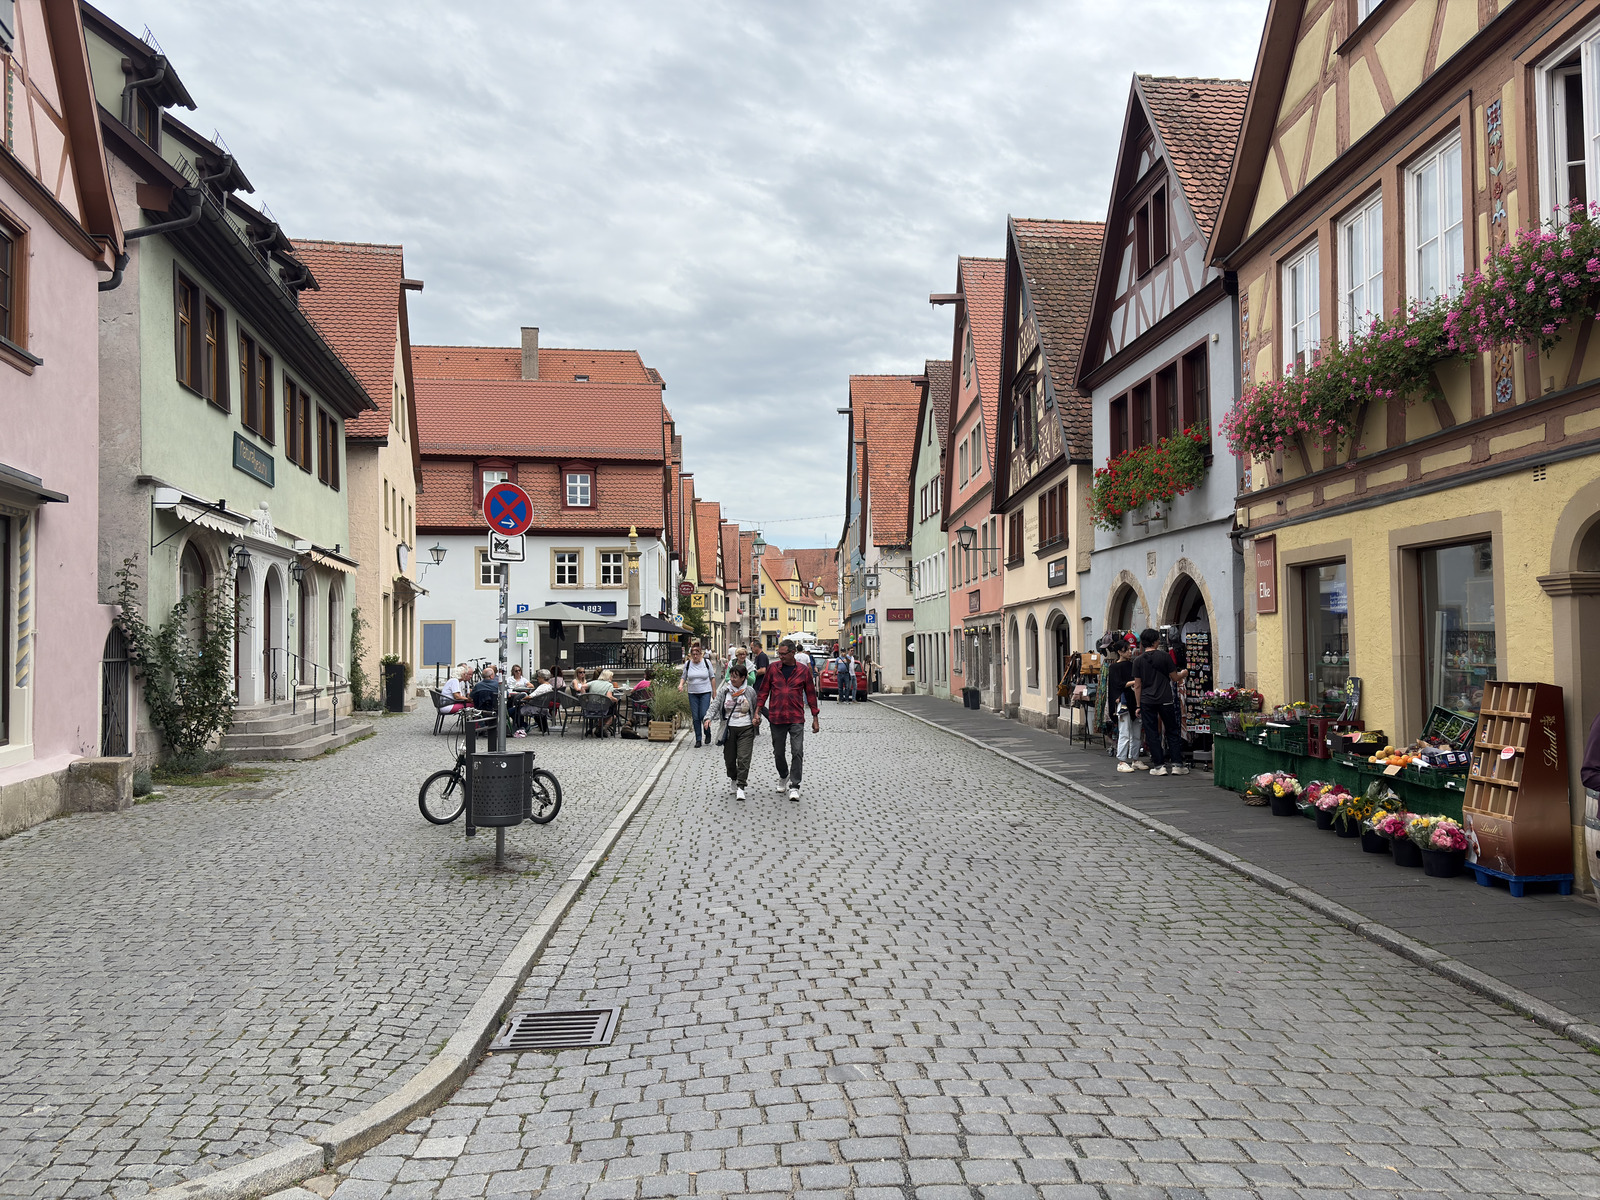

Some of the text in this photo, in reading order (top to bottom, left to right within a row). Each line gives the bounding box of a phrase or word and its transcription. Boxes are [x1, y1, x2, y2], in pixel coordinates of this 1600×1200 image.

[1257, 554, 1271, 568] Pension
[1260, 582, 1270, 598] Elke
[1543, 726, 1558, 770] Lindt
[1480, 822, 1498, 834] Lindt
